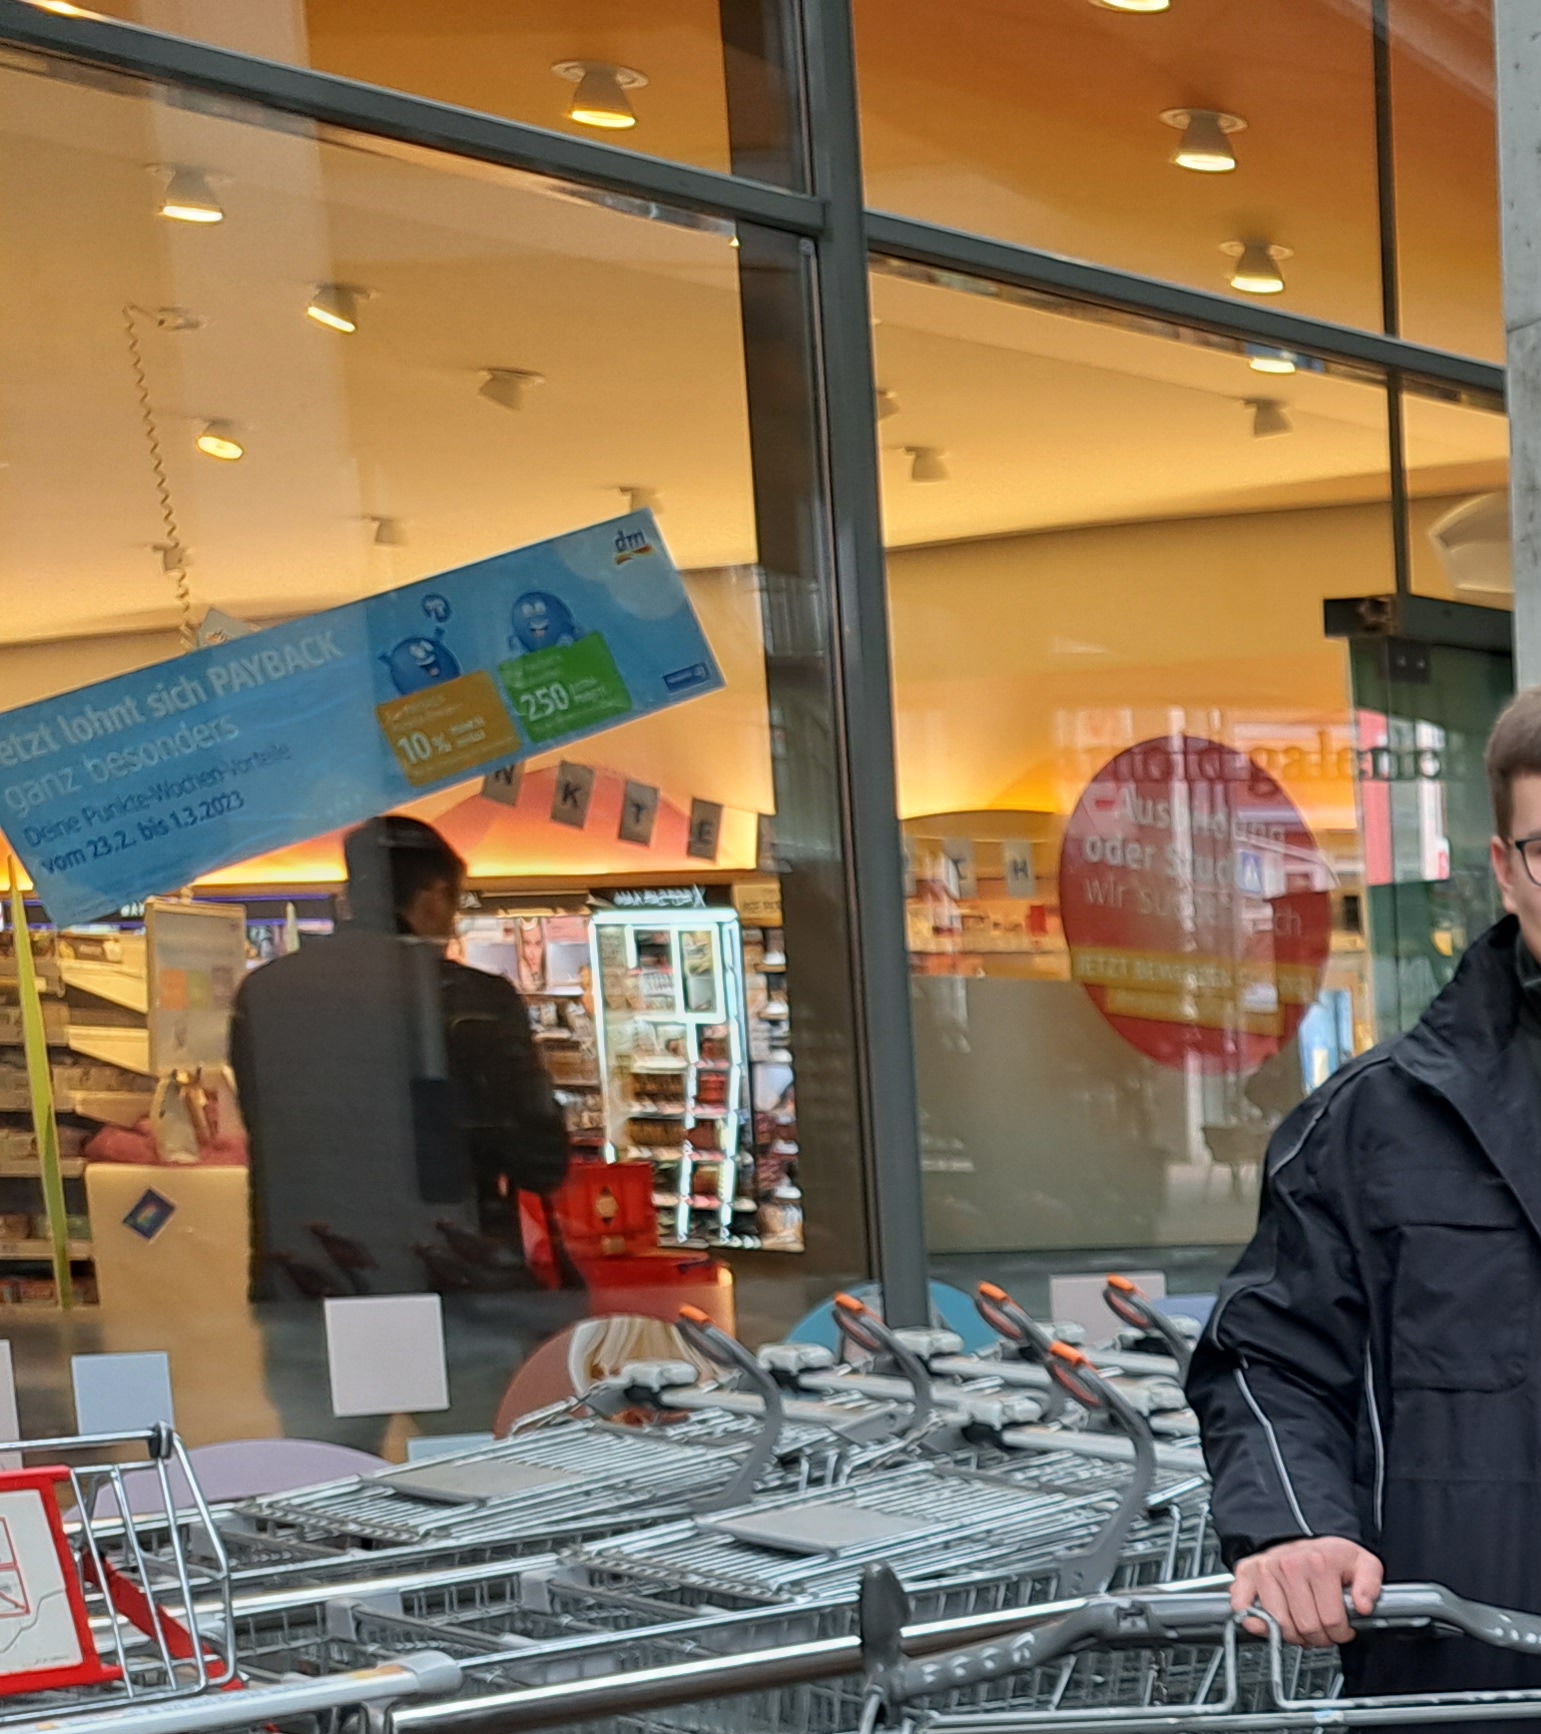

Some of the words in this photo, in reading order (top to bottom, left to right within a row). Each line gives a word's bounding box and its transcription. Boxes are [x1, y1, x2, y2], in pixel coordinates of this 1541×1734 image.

[614, 529, 648, 552] dm
[58, 695, 145, 747] lohnt
[147, 673, 207, 719] sich
[206, 630, 344, 697] PAYBACK
[520, 682, 570, 722] 250
[5, 764, 83, 818] ganz
[82, 714, 240, 784] besonders
[40, 845, 87, 876] vom
